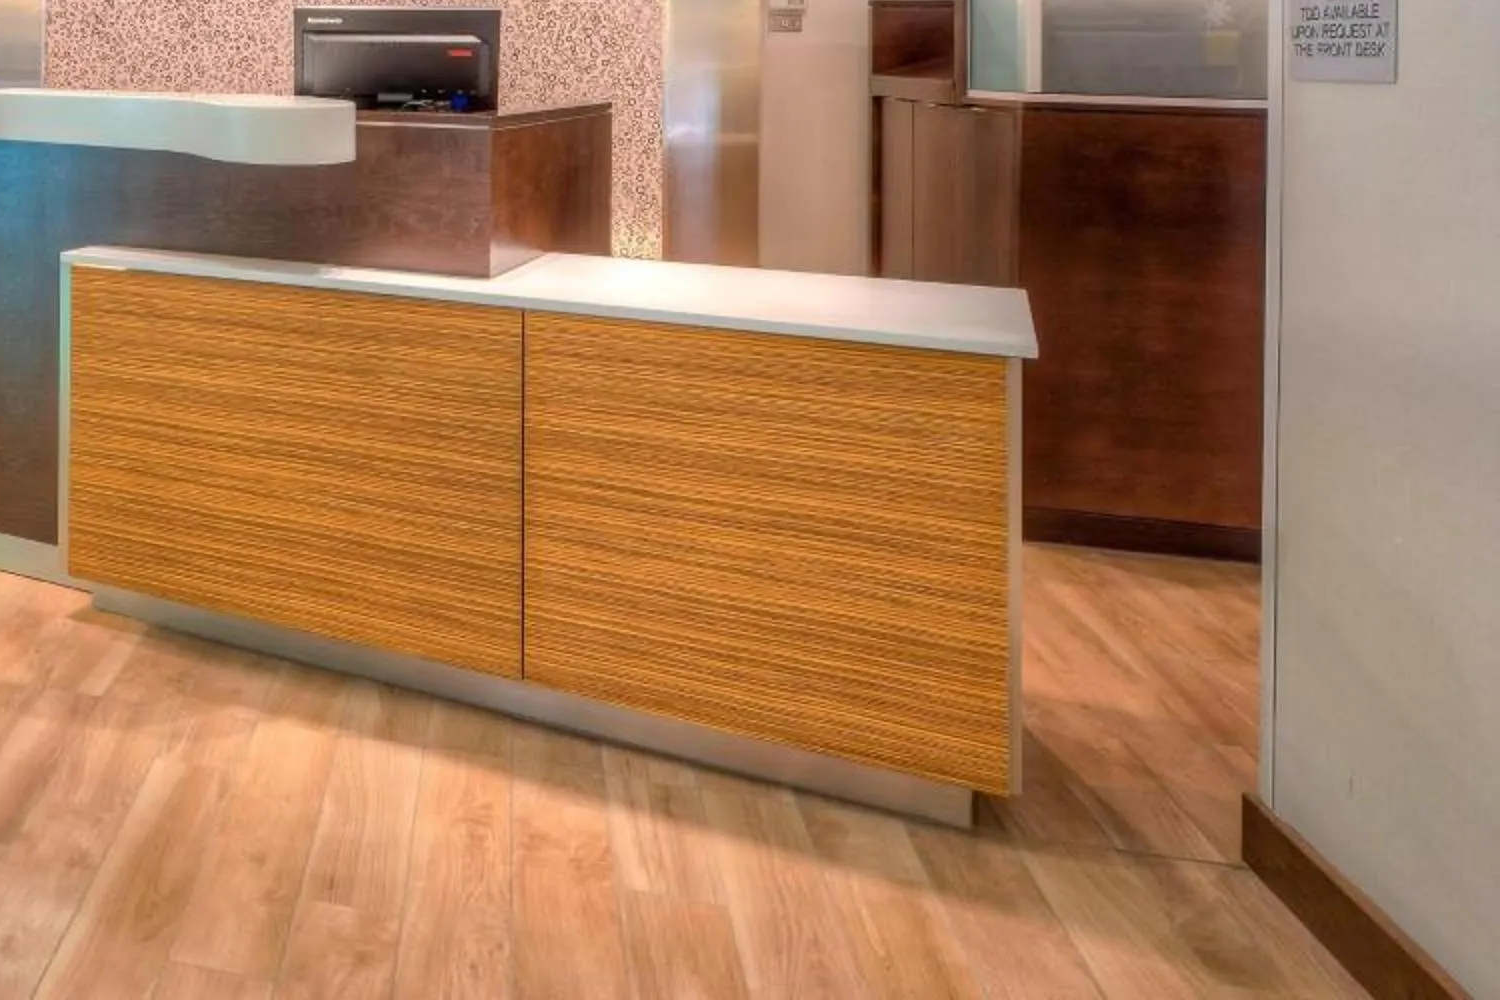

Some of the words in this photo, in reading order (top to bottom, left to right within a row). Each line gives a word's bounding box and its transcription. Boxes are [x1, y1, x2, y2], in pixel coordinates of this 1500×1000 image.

[1323, 3, 1380, 20] AVAILABLE
[1291, 24, 1319, 39] UPON
[1322, 23, 1372, 38] REQUEST
[1375, 22, 1390, 38] AT
[1293, 43, 1314, 57] THE
[1317, 42, 1353, 57] FRONT
[1355, 41, 1386, 57] DESK
